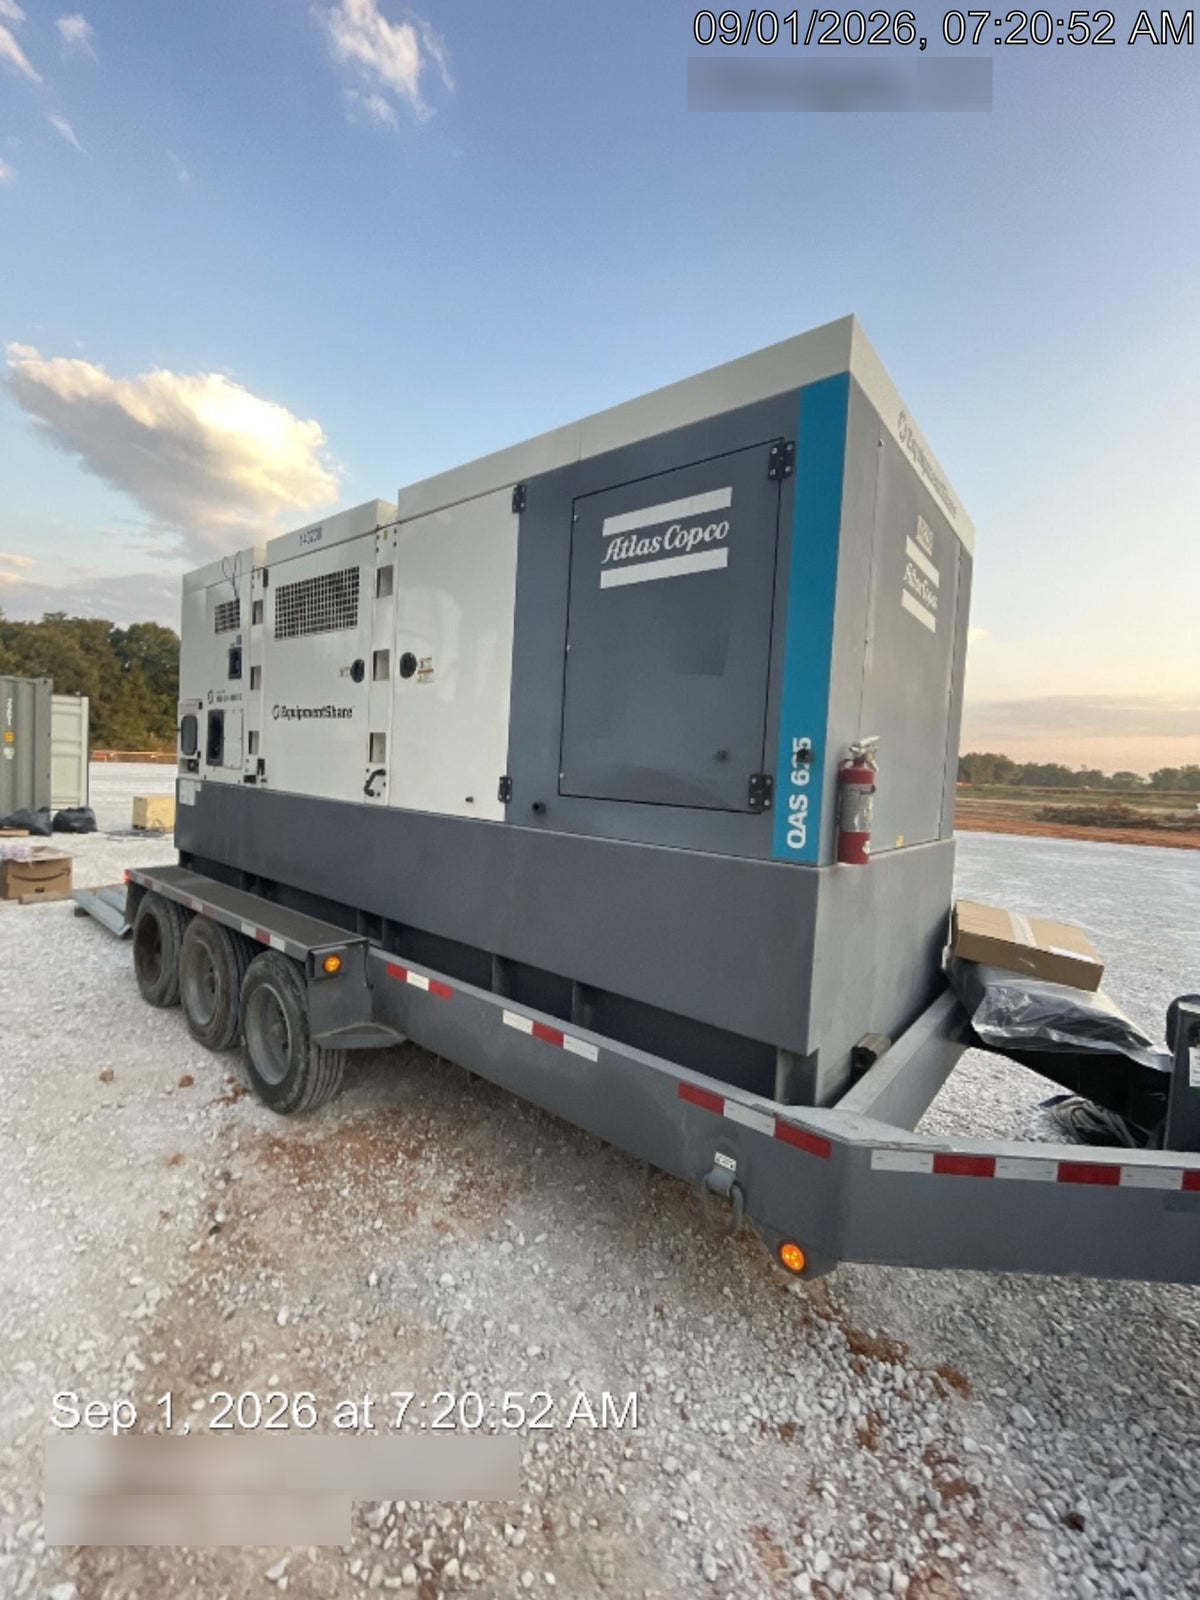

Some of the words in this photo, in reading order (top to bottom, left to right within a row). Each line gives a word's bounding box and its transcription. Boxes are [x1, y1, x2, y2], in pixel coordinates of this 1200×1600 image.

[601, 534, 662, 564] Atlas
[663, 520, 730, 552] Copco
[786, 794, 809, 849] QAS
